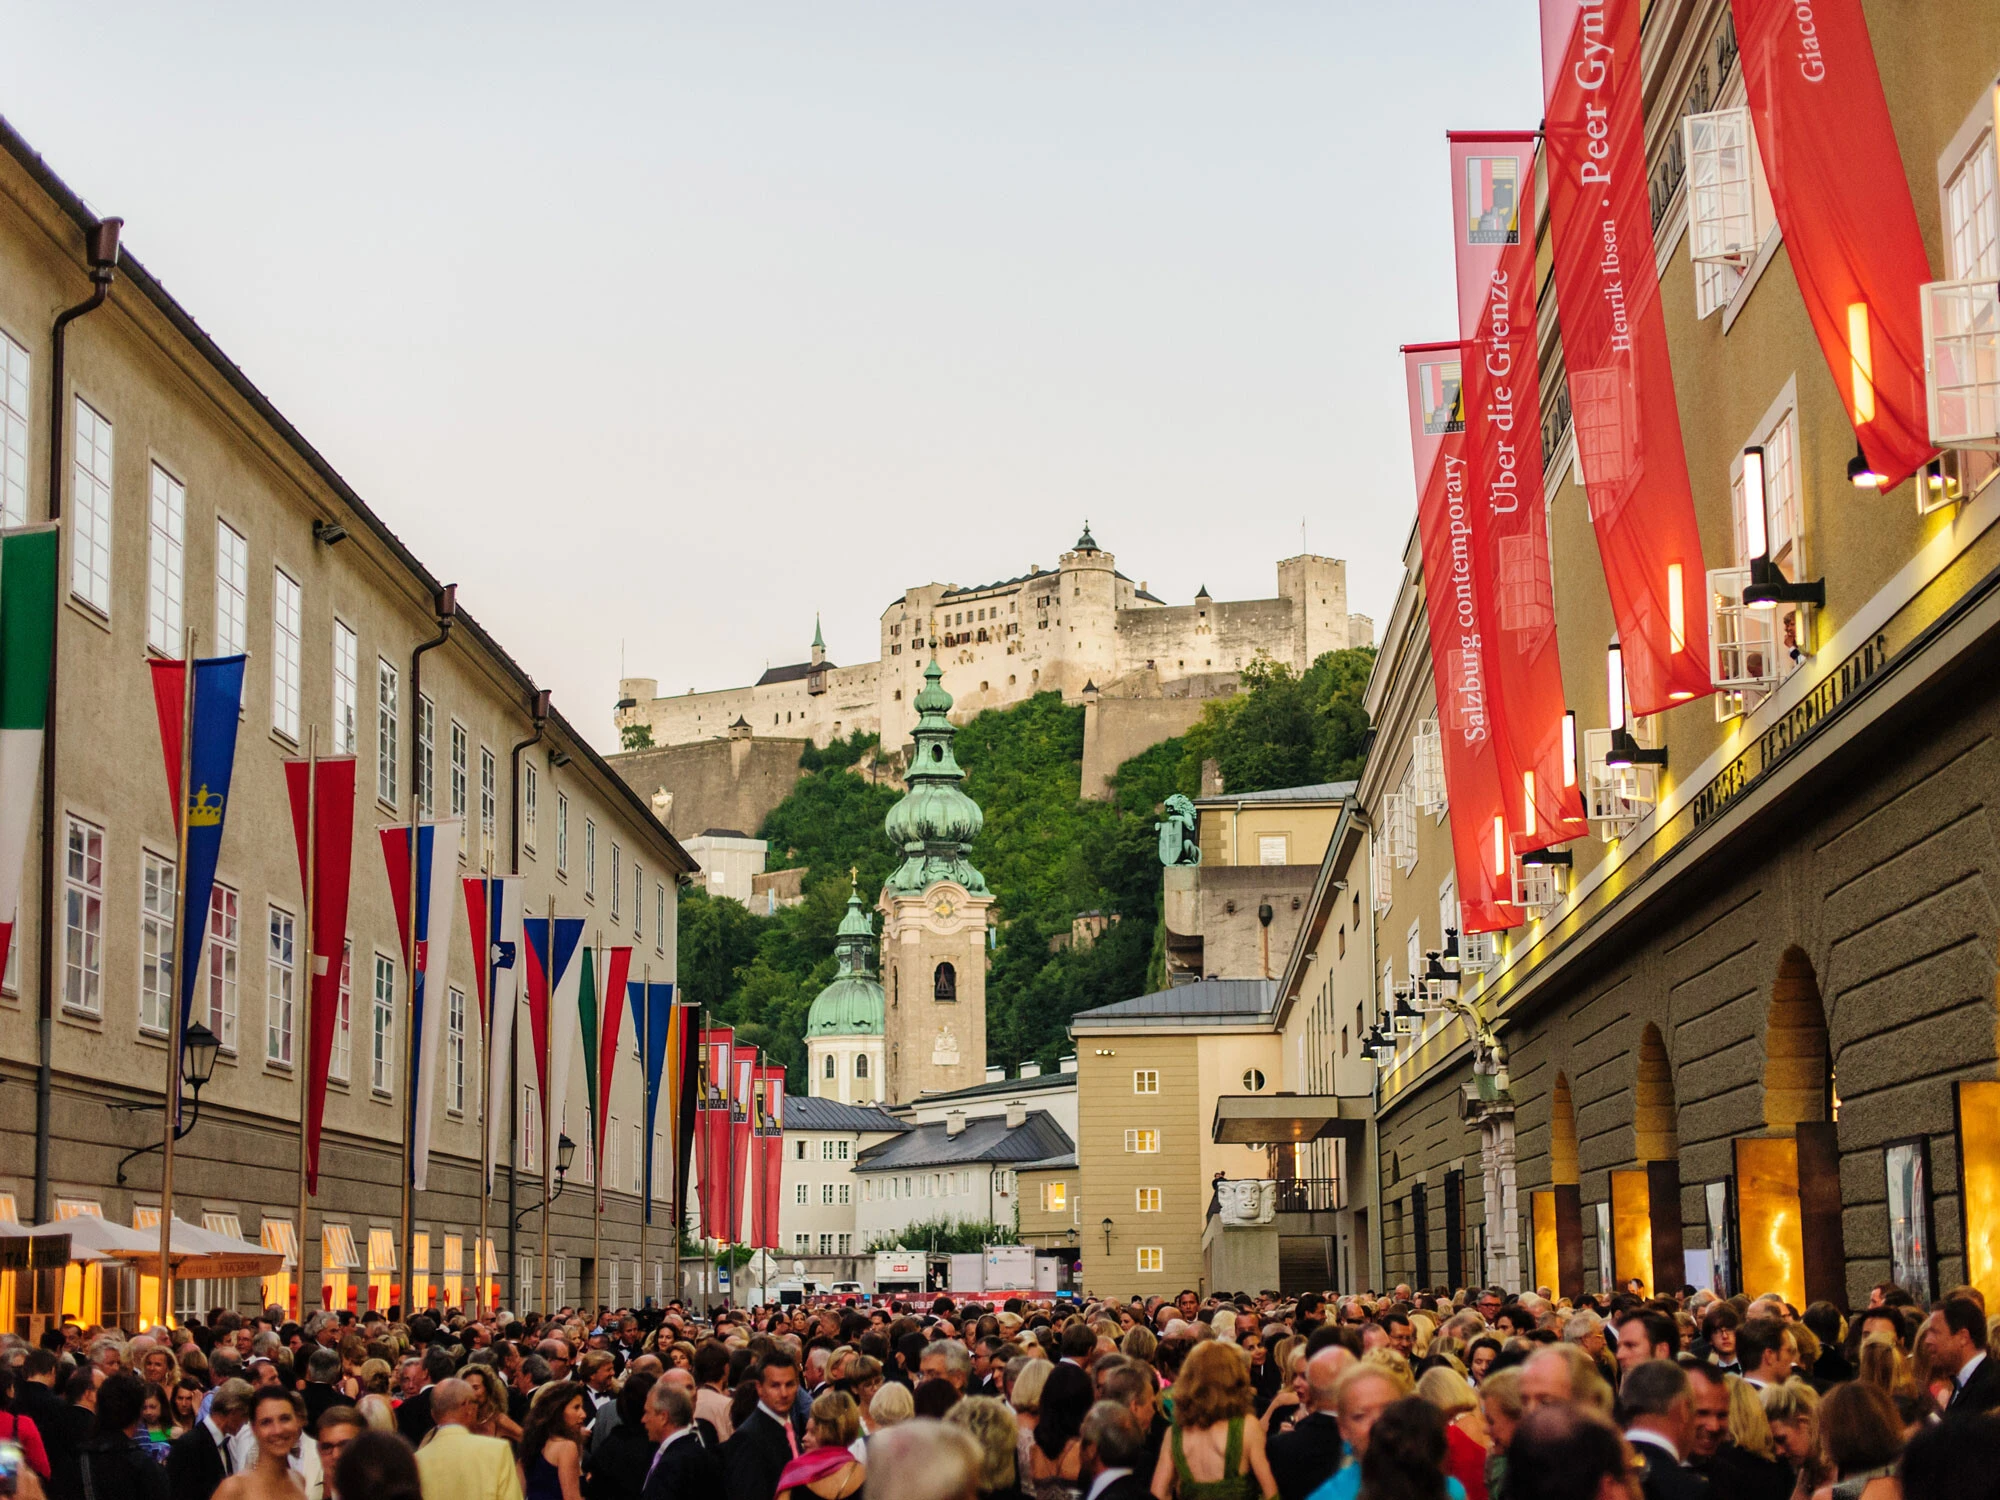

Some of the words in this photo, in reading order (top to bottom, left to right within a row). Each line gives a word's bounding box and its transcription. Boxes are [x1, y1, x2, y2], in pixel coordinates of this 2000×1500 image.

[1795, 0, 1826, 82] Giaco
[1580, 102, 1612, 186] Peer
[1600, 219, 1621, 275] Ibsen
[1486, 269, 1511, 377] Grenze
[1604, 280, 1631, 352] Henrik
[1487, 386, 1514, 431] die
[1488, 440, 1519, 516] Über
[1444, 453, 1475, 628] contemporary
[1458, 633, 1486, 741] Salzburg
[1761, 634, 1886, 771] FESTSPIELHAUS
